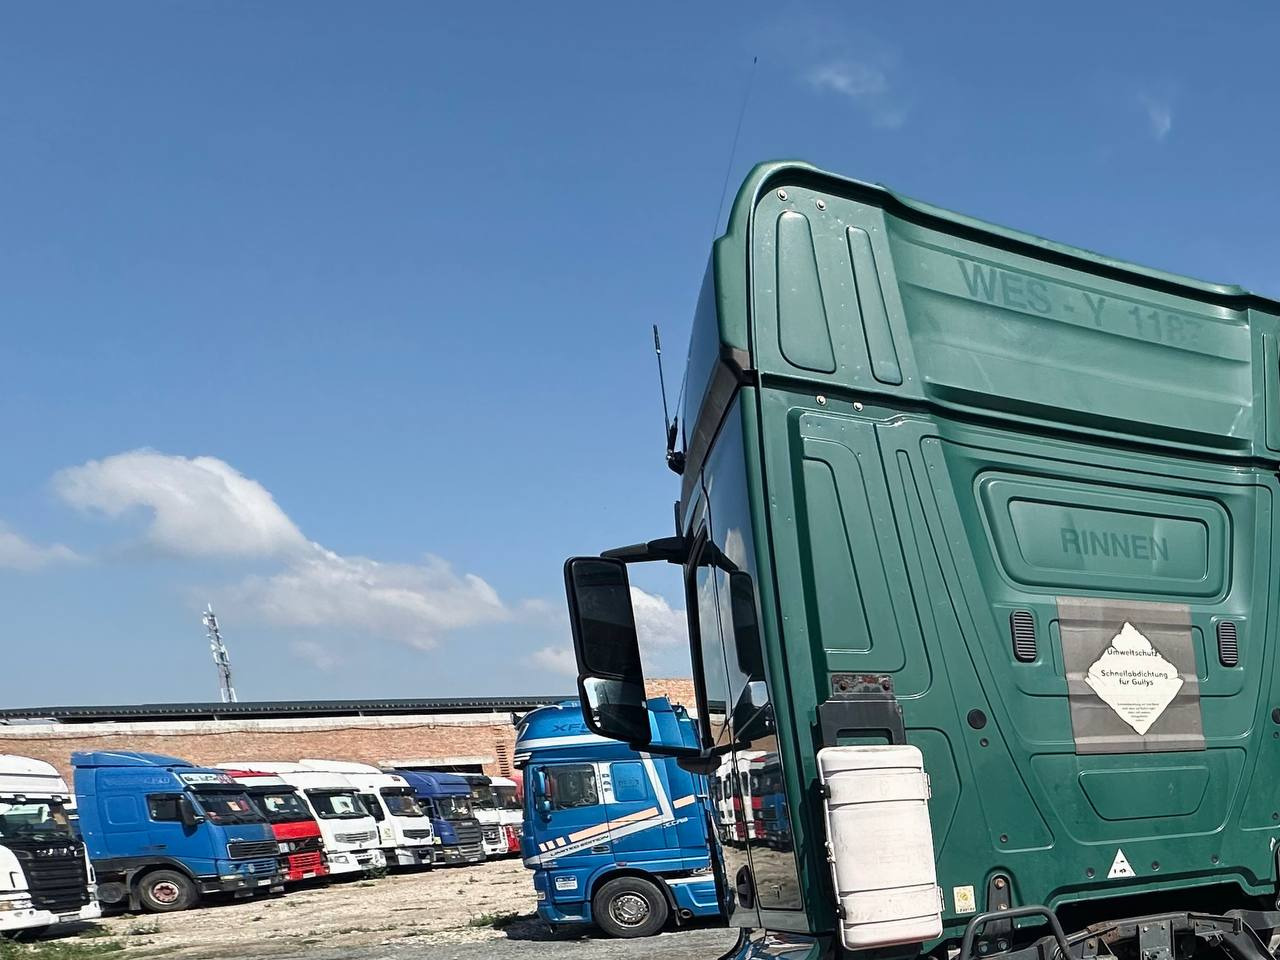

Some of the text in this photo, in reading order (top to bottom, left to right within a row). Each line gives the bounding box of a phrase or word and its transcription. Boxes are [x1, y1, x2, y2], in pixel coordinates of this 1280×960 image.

[958, 258, 1050, 315] WES
[1082, 292, 1107, 329] Y
[1061, 527, 1169, 562] RINNEN
[1107, 648, 1158, 658] Umweltschutz
[1100, 669, 1168, 680] Schnellabdichtung
[1131, 678, 1154, 688] Gullys
